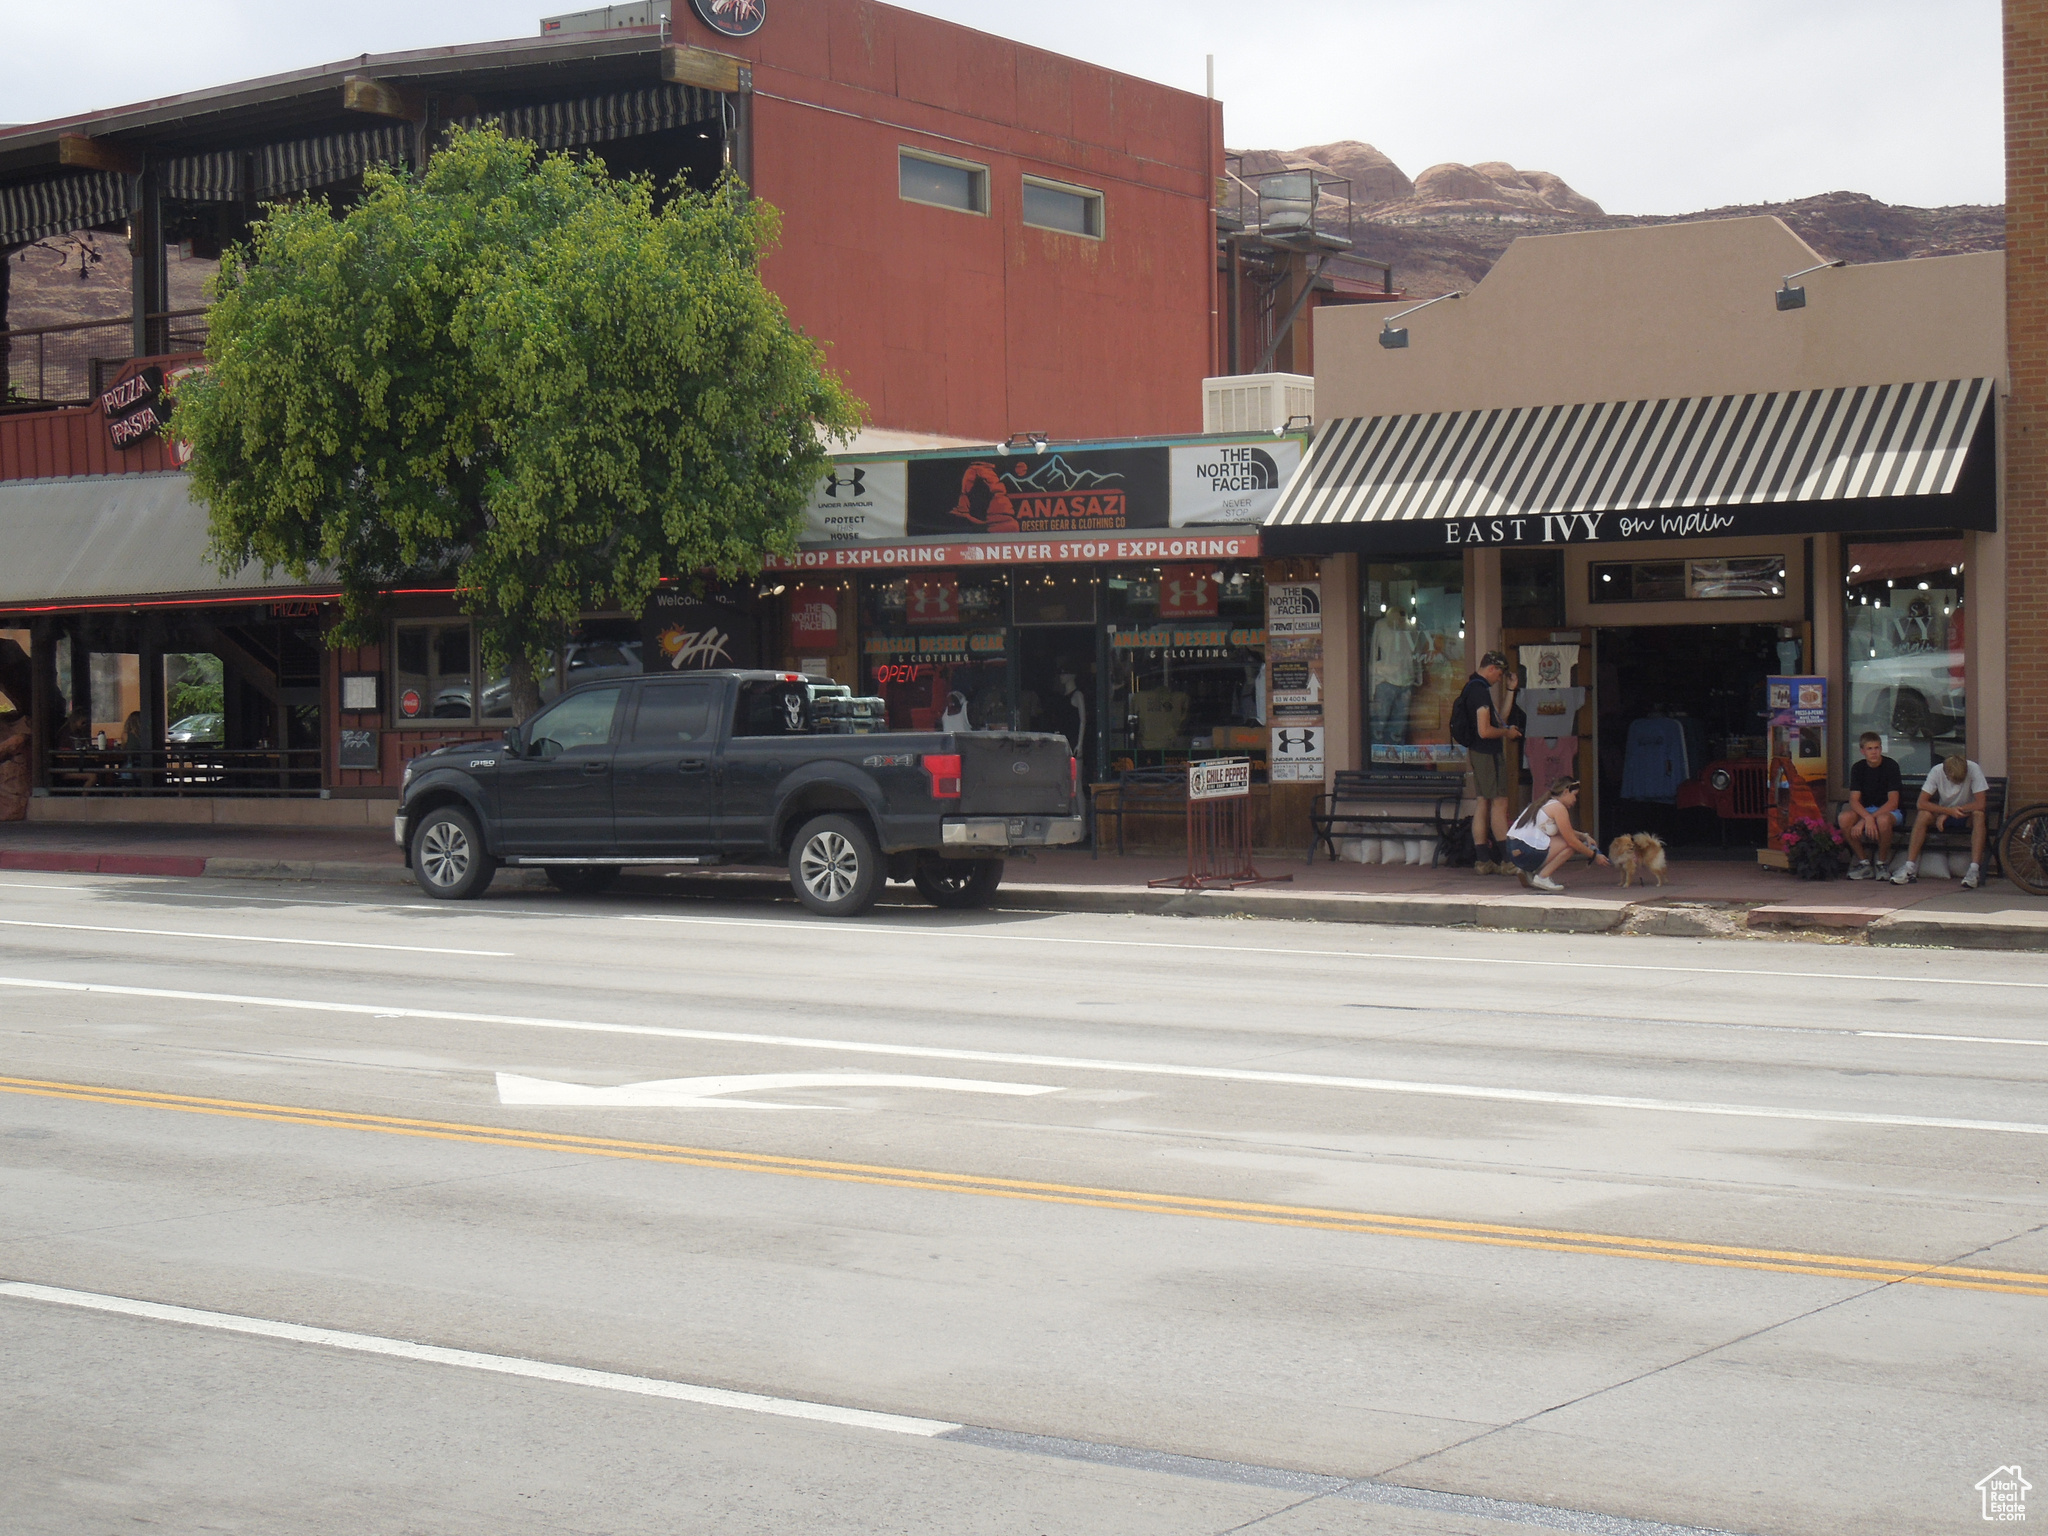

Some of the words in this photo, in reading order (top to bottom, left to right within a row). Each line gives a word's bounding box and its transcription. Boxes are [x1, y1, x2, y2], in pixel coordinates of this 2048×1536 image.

[101, 375, 152, 414] PIZZA
[111, 407, 160, 445] PASTA
[1220, 448, 1250, 462] THE
[1197, 462, 1250, 478] NORTH
[1212, 477, 1250, 492] FACE
[1016, 495, 1126, 519] ANASAZI
[1222, 499, 1252, 508] NEVER
[824, 515, 866, 524] PROTECT
[1225, 508, 1249, 517] STOP
[836, 524, 854, 532] THIS
[1021, 519, 1049, 532] DESERT
[1050, 518, 1070, 531] GEAR
[1071, 518, 1077, 530] &
[1078, 517, 1114, 530] CLOTHING
[1115, 516, 1126, 528] CO
[1445, 519, 1527, 544] EAST
[1541, 512, 1604, 543] IVY
[1619, 516, 1656, 537] on
[1660, 507, 1734, 536] main
[830, 532, 860, 541] HOUSE
[986, 544, 1052, 560] NEVER
[1060, 542, 1110, 558] STOP
[1282, 587, 1301, 596] THE
[804, 603, 822, 613] THE
[1269, 596, 1301, 606] NORTH
[272, 602, 319, 617] PIZZA
[1278, 605, 1301, 615] FACE
[792, 612, 822, 622] NORTH
[800, 621, 822, 631] FACE
[1294, 621, 1320, 631] CAMELBAK
[1881, 616, 1934, 641] IVY
[864, 637, 916, 654] ANASAZI
[919, 635, 968, 653] DESERT
[970, 634, 1005, 651] GEAR
[1114, 630, 1170, 648] ANASAZI
[1173, 629, 1229, 647] DESERT
[911, 653, 969, 663] CLOTHING
[1163, 649, 1228, 659] CLOTHING
[877, 664, 919, 683] OPEN
[1206, 768, 1224, 784] CHILE
[1225, 766, 1248, 782] PEPPER
